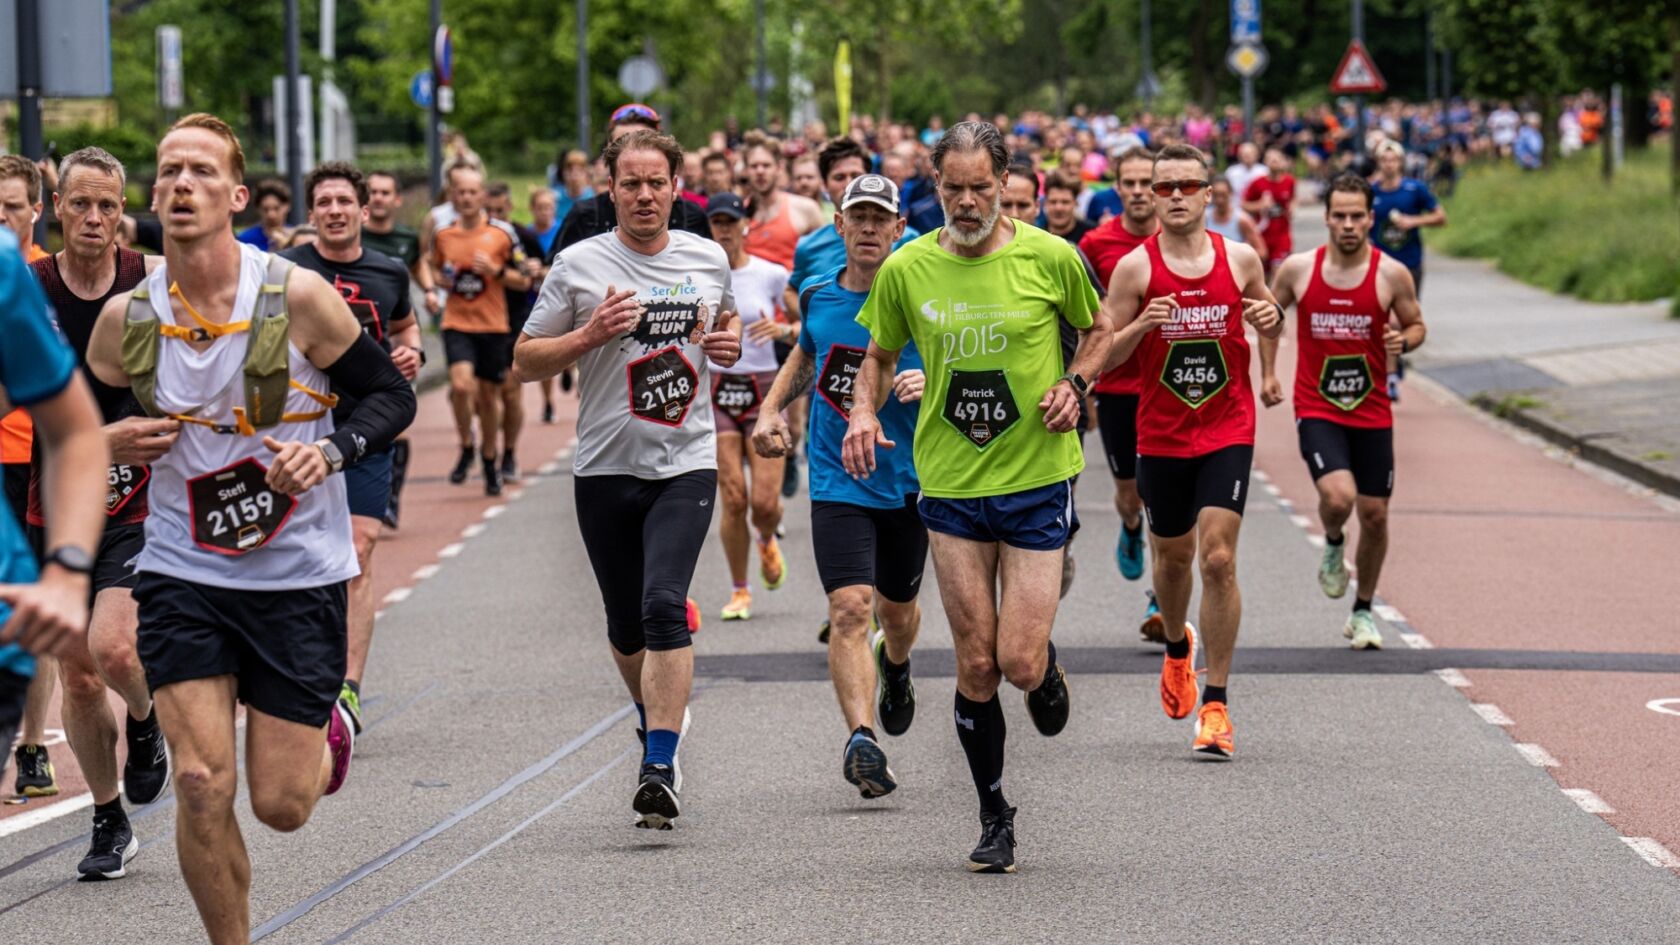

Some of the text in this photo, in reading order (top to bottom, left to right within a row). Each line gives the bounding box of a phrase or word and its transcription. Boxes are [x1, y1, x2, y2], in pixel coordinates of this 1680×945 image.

[646, 310, 694, 323] BUFFEL
[955, 310, 1030, 321] TILBURG TEN MILES
[1171, 305, 1229, 324] UNSHOP
[1311, 312, 1373, 328] RUNSHOP
[648, 321, 686, 336] RUN
[1188, 323, 1206, 331] VAN
[943, 321, 1008, 365] 2015
[843, 363, 860, 374] Dav
[1183, 356, 1207, 365] David
[646, 369, 675, 385] Stevin
[1172, 367, 1218, 384] 3456
[1327, 375, 1365, 393] 4627
[641, 377, 690, 410] 2148
[962, 388, 995, 398] Patrick
[954, 401, 1007, 421] 4916
[217, 482, 247, 501] Steff
[207, 491, 274, 537] 2159
